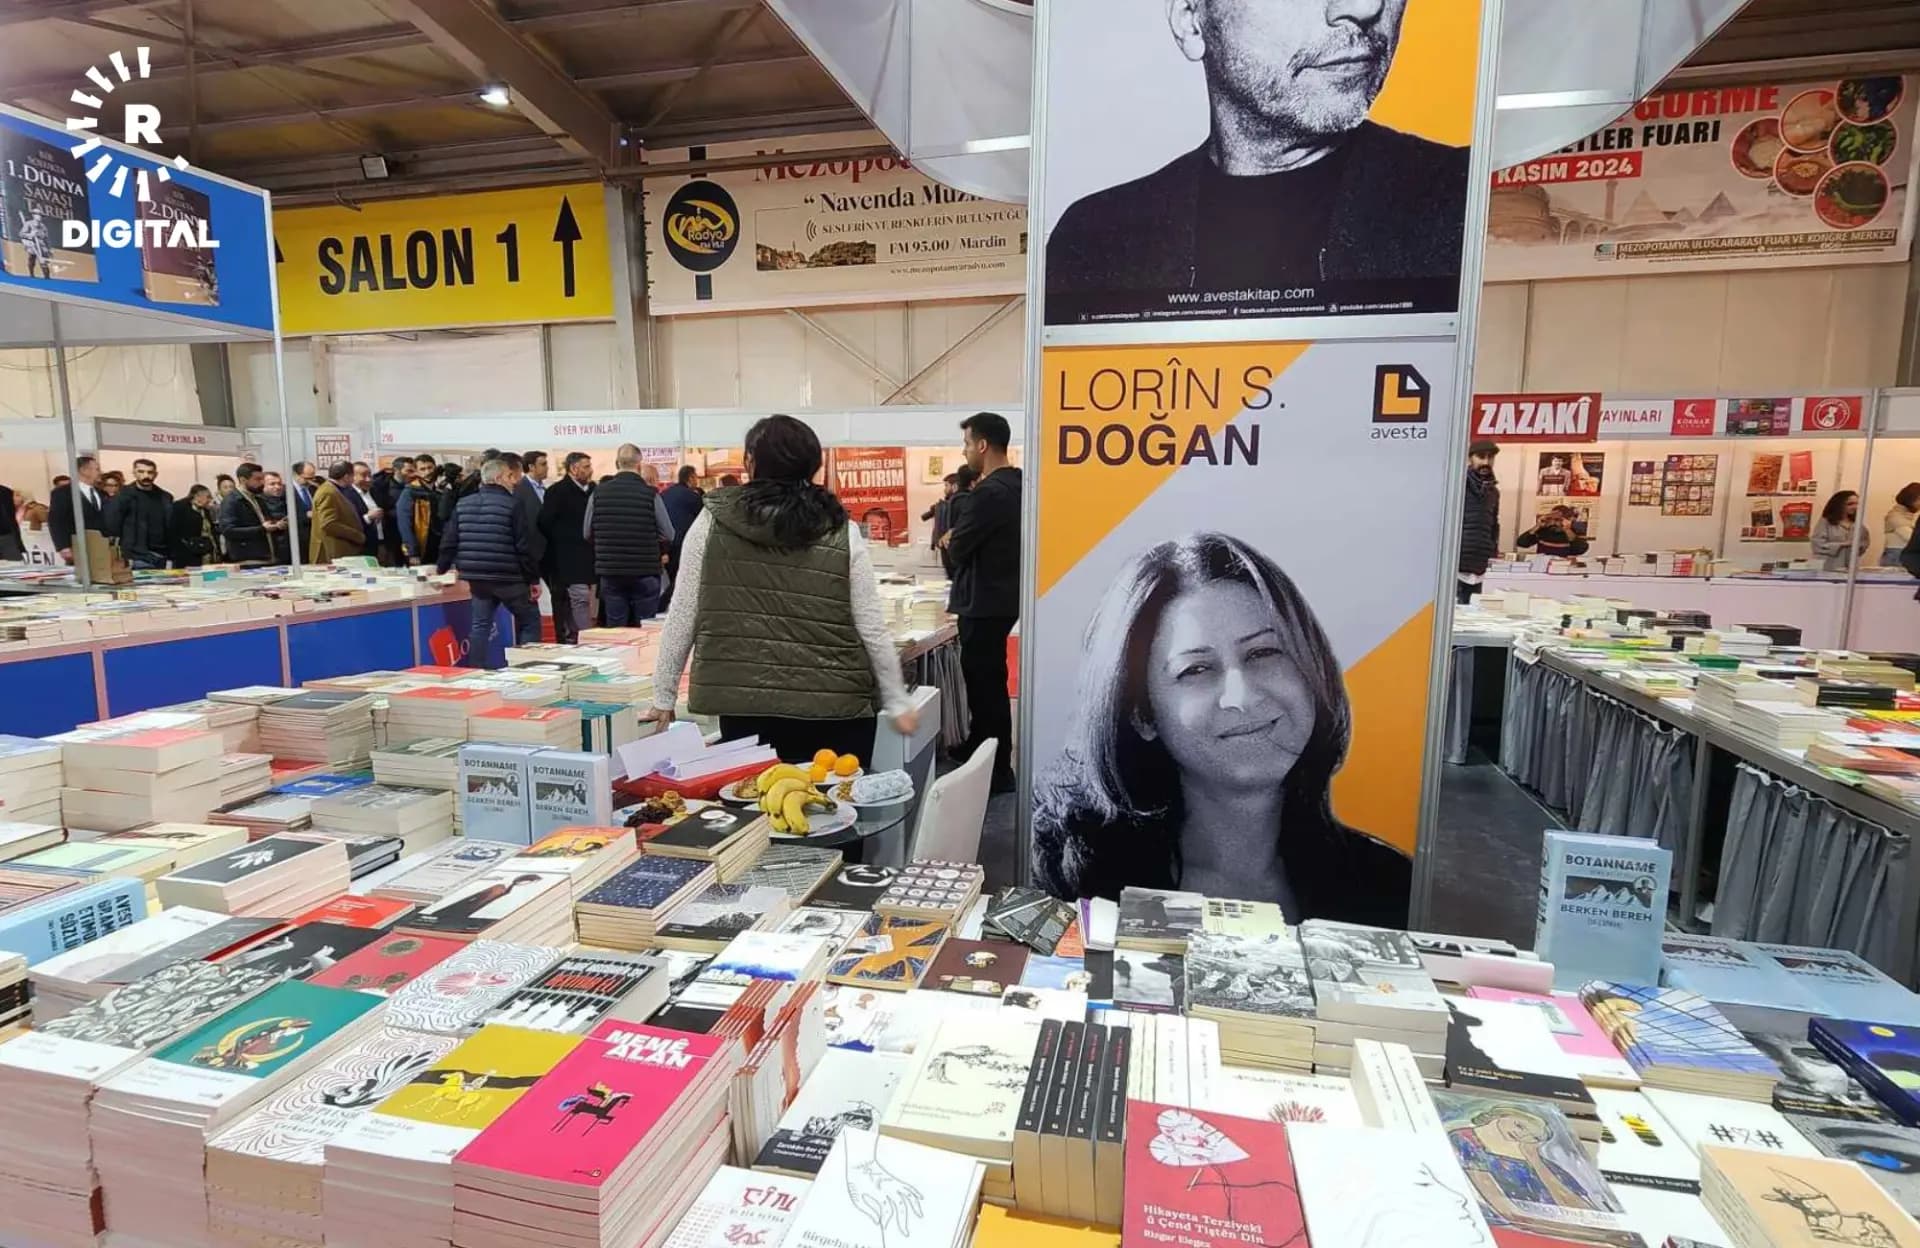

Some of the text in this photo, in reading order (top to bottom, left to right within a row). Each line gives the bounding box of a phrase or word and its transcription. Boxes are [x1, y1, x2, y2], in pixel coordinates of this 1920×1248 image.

[1642, 120, 1721, 147] FUARI
[1498, 156, 1634, 184] KASIM 2024
[889, 241, 910, 255] FM
[912, 239, 950, 253] 95.00
[960, 235, 1007, 249] Mardin
[1619, 240, 1690, 253] MEZOPOTAMYA
[1807, 232, 1848, 244] KONGRE
[318, 223, 520, 295] SALON 1
[1167, 286, 1315, 305] www.avestakitap.com
[1059, 357, 1287, 412] LORÎN S.
[1477, 396, 1593, 435] ZAZAKÎ
[1058, 412, 1261, 466] DOĞAN
[1371, 424, 1428, 440] avesta
[838, 468, 905, 489] YILDIRIM
[464, 759, 518, 770] BOTANNAME
[533, 766, 586, 778] BOTANNAME
[1565, 854, 1657, 874] BOTANNAME
[1560, 903, 1653, 922] BERKEN BEREH
[605, 1028, 691, 1053] MEMÊ
[602, 1044, 693, 1069] ALAN
[1143, 1203, 1199, 1222] Hikayeta
[1158, 1217, 1192, 1232] Çend
